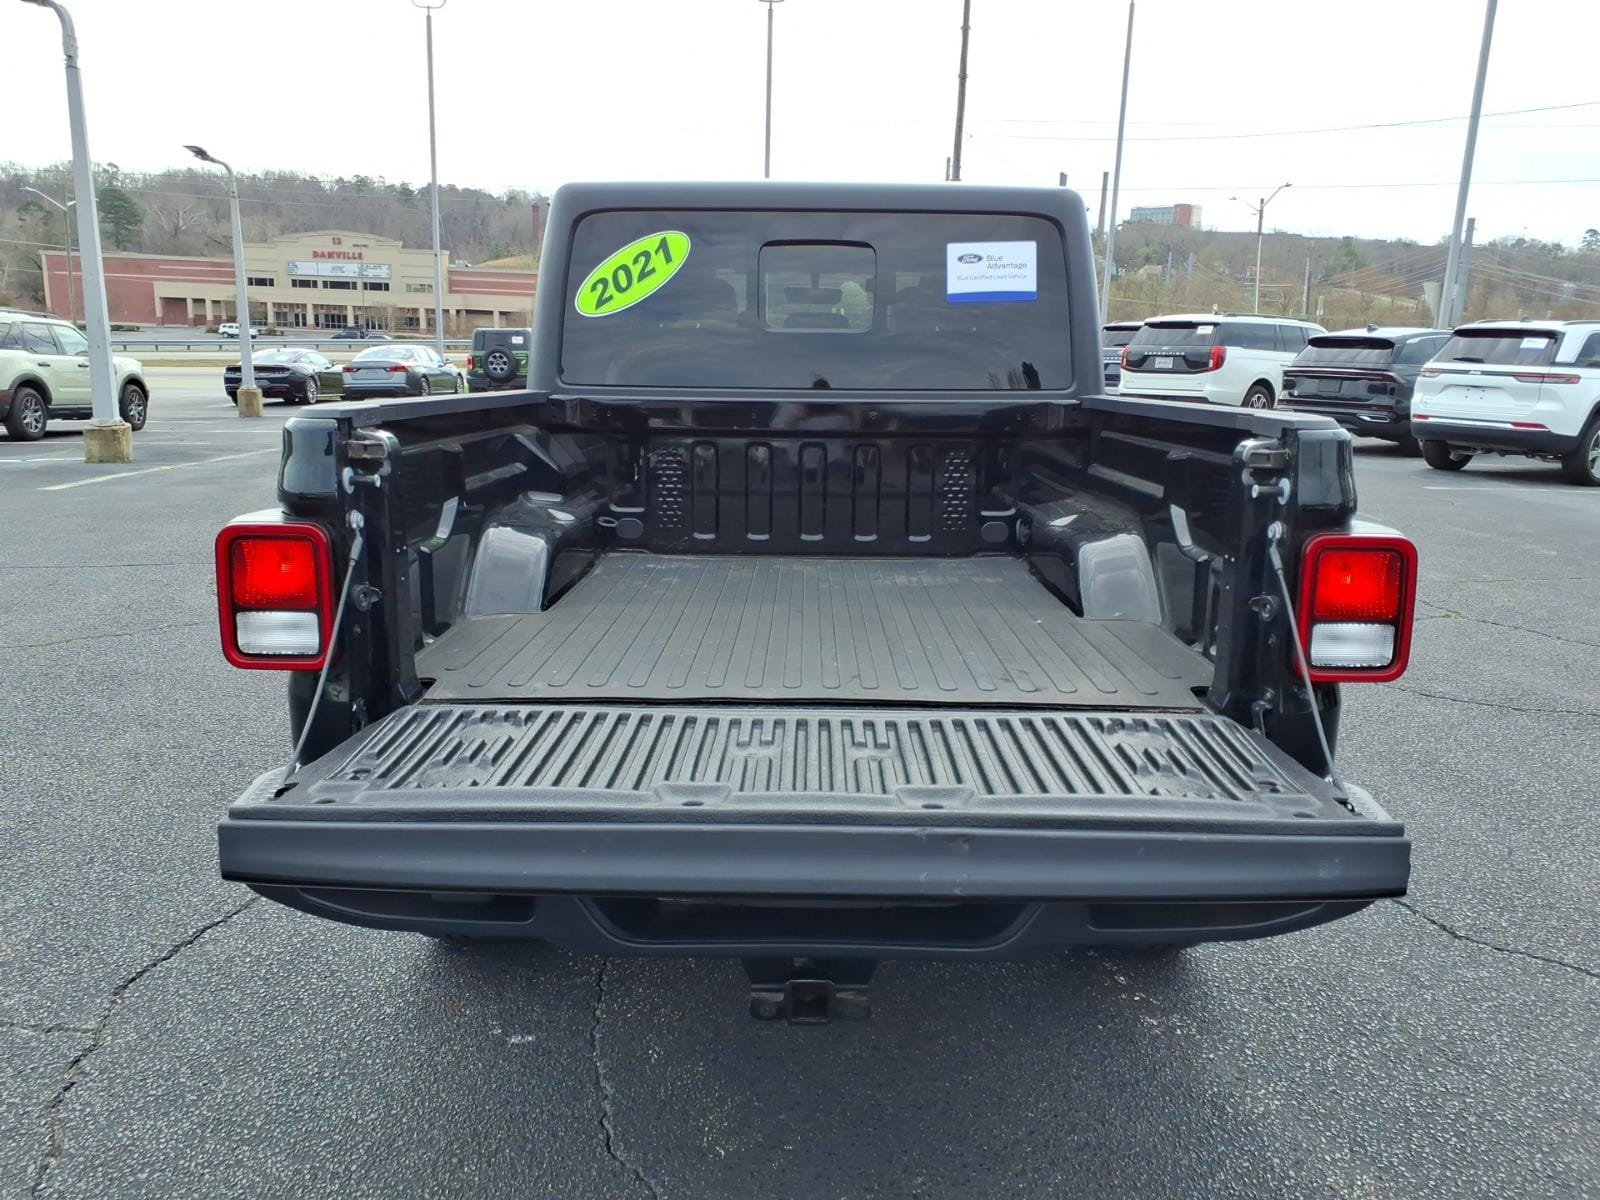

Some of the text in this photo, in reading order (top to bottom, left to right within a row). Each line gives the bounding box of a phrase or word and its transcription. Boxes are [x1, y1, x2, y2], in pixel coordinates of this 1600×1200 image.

[312, 250, 363, 260] DANVILLE
[959, 254, 981, 264] Ford
[986, 263, 1028, 271] Advantage
[590, 236, 673, 311] 2021
